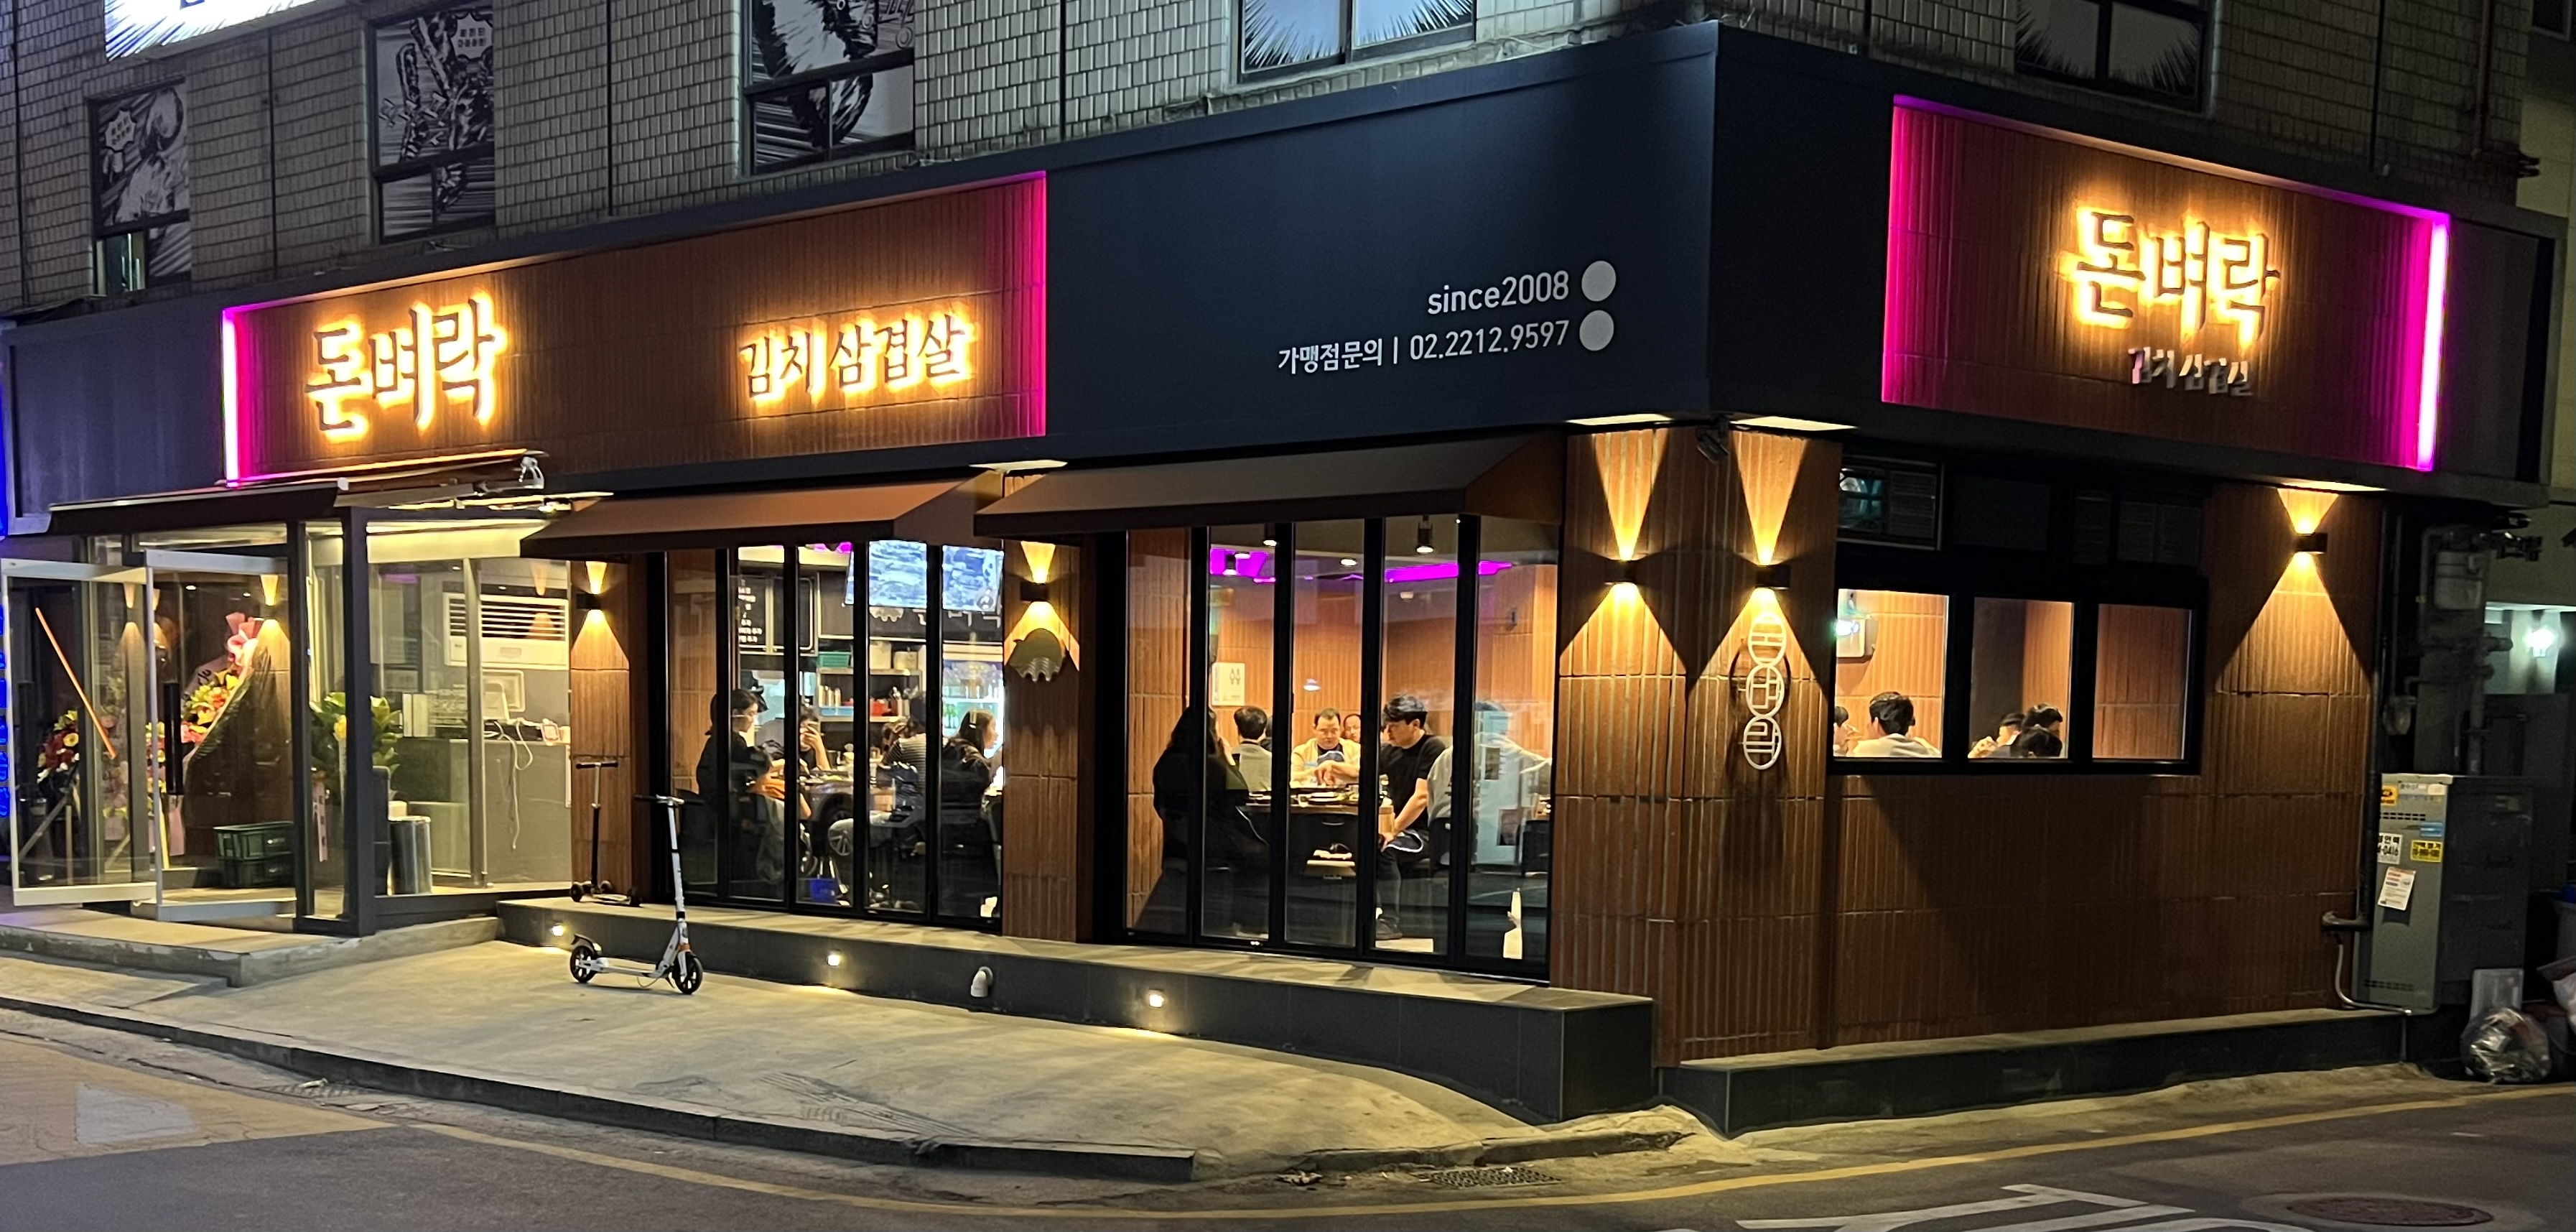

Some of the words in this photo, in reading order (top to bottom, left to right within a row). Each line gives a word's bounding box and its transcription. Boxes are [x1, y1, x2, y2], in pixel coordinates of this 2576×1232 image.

[1427, 269, 1570, 315] since2008
[2073, 211, 2281, 343] 돈벼락
[304, 295, 497, 432] 돈벼락
[739, 330, 814, 399] 김치
[829, 313, 967, 389] 삼겹살
[1278, 338, 1383, 375] 가맹점문의
[1409, 319, 1570, 361] 02.2212.9597
[2128, 346, 2175, 389] 김치
[2179, 353, 2252, 396] 삼겹살
